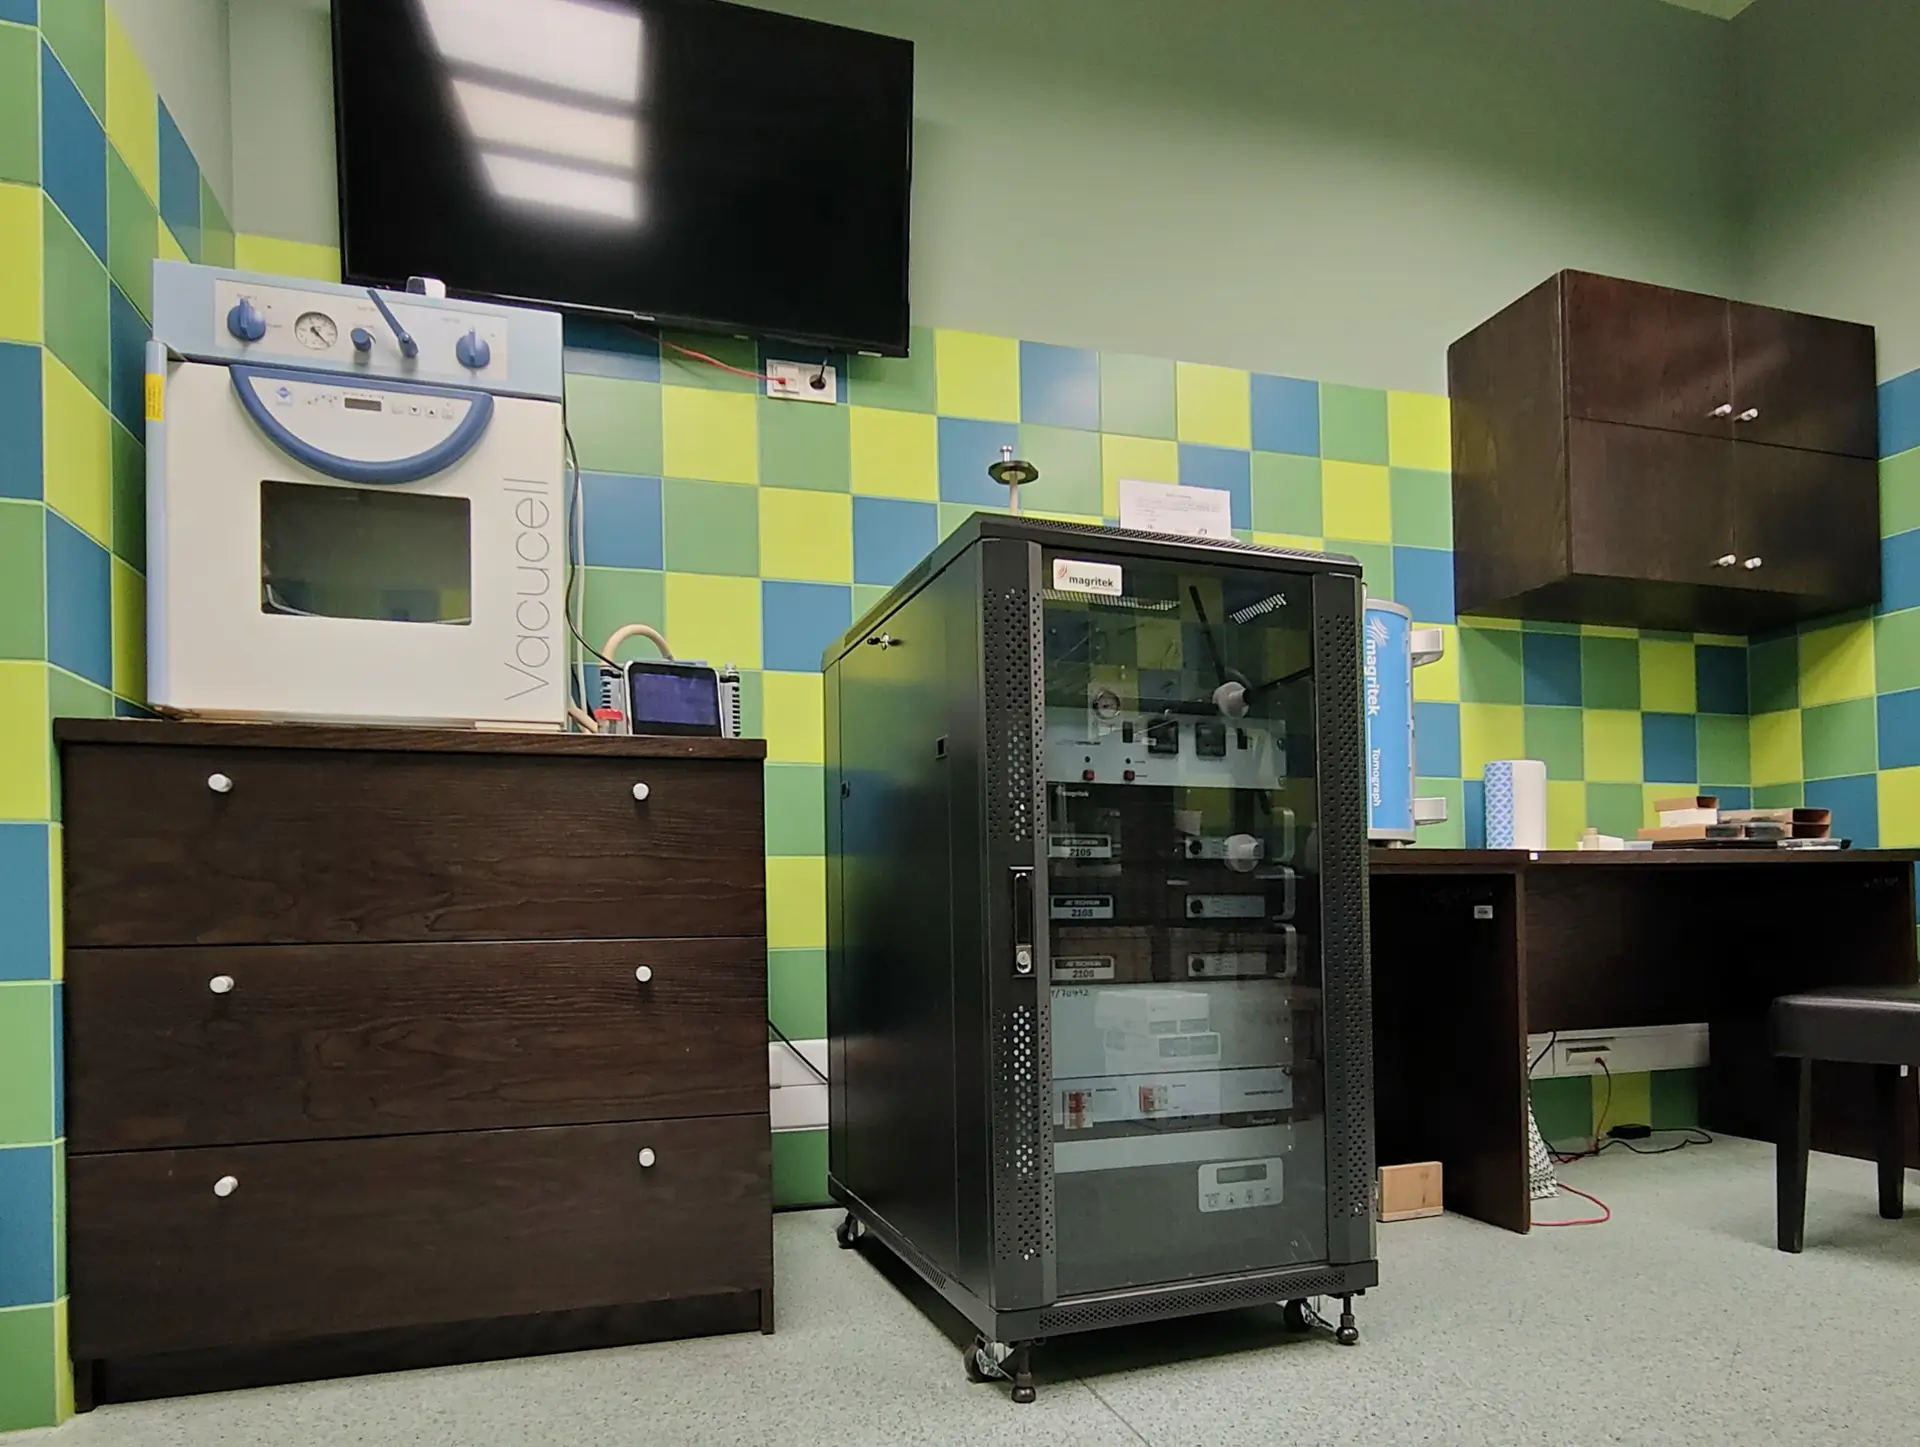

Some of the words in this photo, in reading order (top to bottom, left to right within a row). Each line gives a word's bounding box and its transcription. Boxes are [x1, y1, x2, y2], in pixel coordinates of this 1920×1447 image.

[503, 478, 551, 701] Vacucell
[1069, 577, 1113, 588] magritek
[1364, 640, 1380, 715] magritek
[1371, 748, 1381, 805] Tomograph
